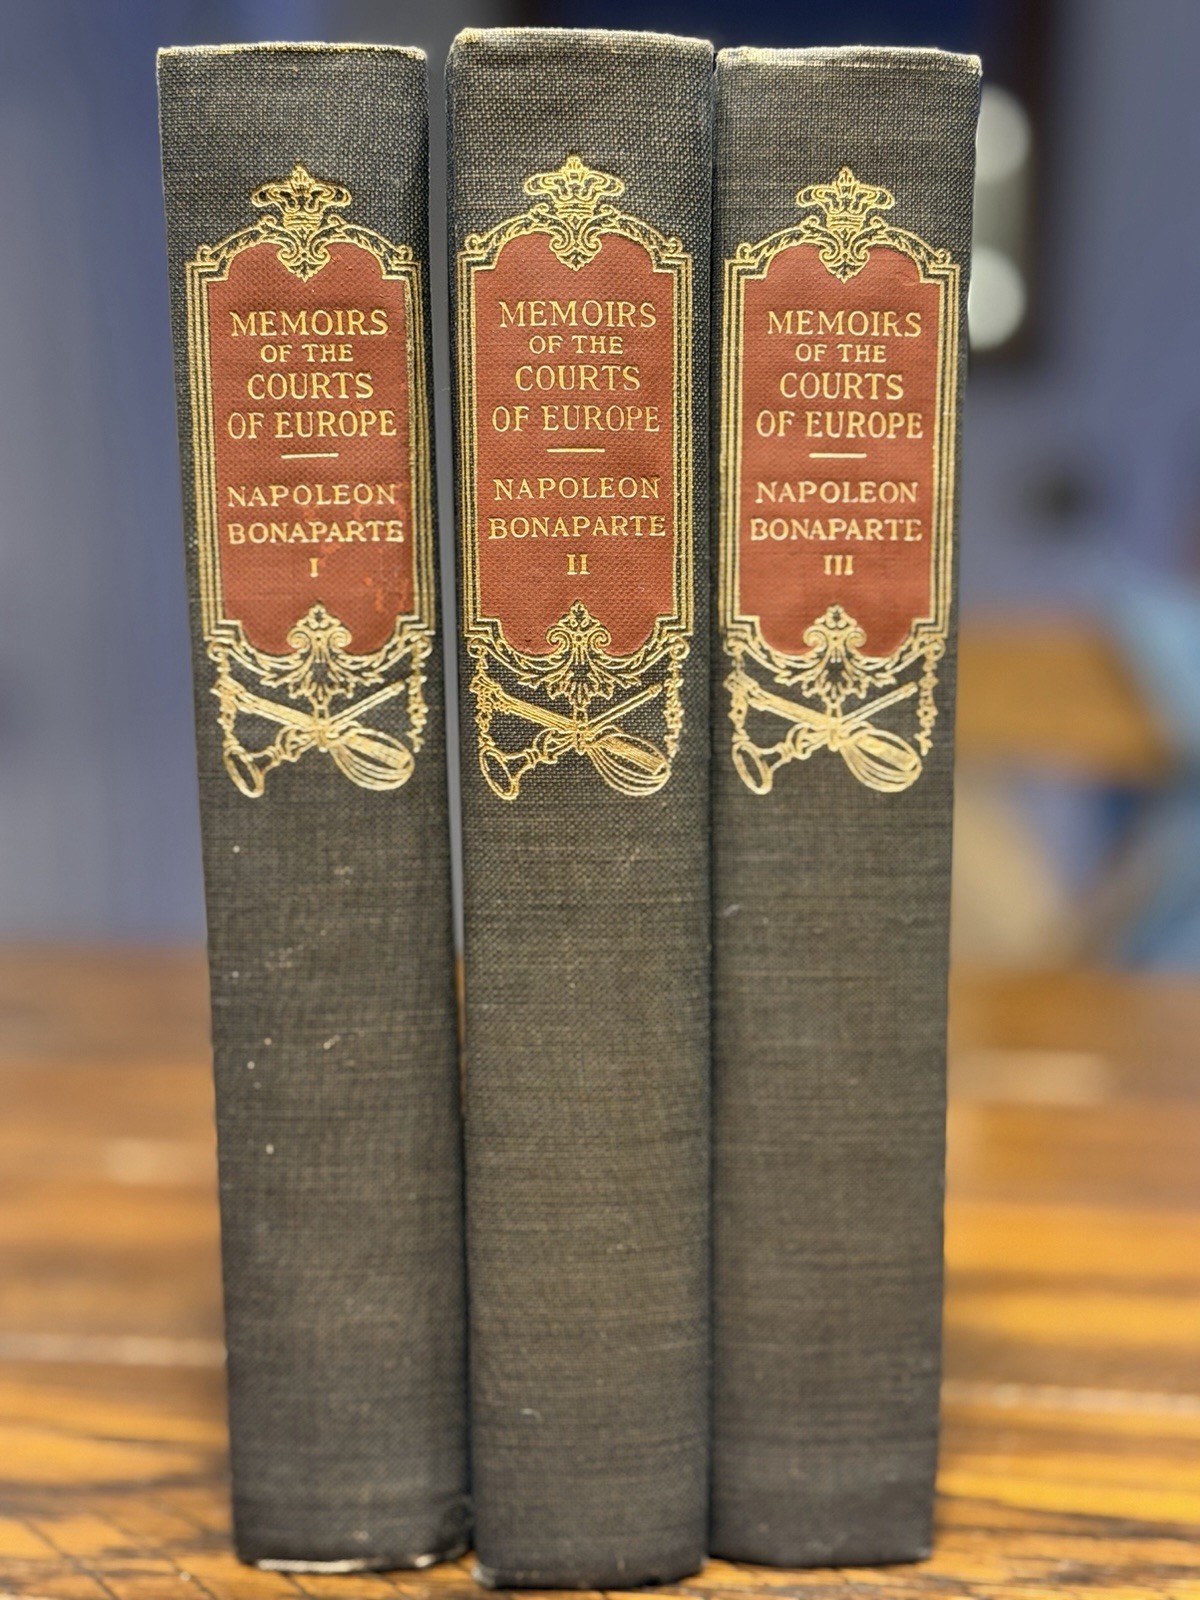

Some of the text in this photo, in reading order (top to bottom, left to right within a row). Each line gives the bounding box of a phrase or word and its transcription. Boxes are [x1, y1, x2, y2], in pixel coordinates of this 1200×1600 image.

[229, 309, 389, 336] MEMOIRS
[499, 300, 657, 328] MEMOIRS
[767, 310, 922, 338] MEMOIRS
[260, 344, 354, 363] OF THE
[529, 335, 624, 355] OF THE
[795, 343, 887, 363] OF THE
[247, 372, 374, 400] COURTS
[515, 365, 641, 392] COURTS
[779, 372, 904, 400] COURTS
[227, 410, 397, 440] OF EUROPE
[492, 405, 660, 433] OF EUROPE
[756, 410, 924, 439] OF EUROPE
[227, 483, 396, 507] NAPOLEON
[493, 476, 661, 501] NAPOLEON
[755, 481, 919, 504] NAPOLEON
[227, 520, 405, 545] BONAPARTE
[488, 515, 666, 540] BONAPARTE
[750, 517, 922, 542] BONAPARTE
[309, 557, 319, 578] I
[566, 553, 591, 576] II
[823, 554, 854, 576] III
